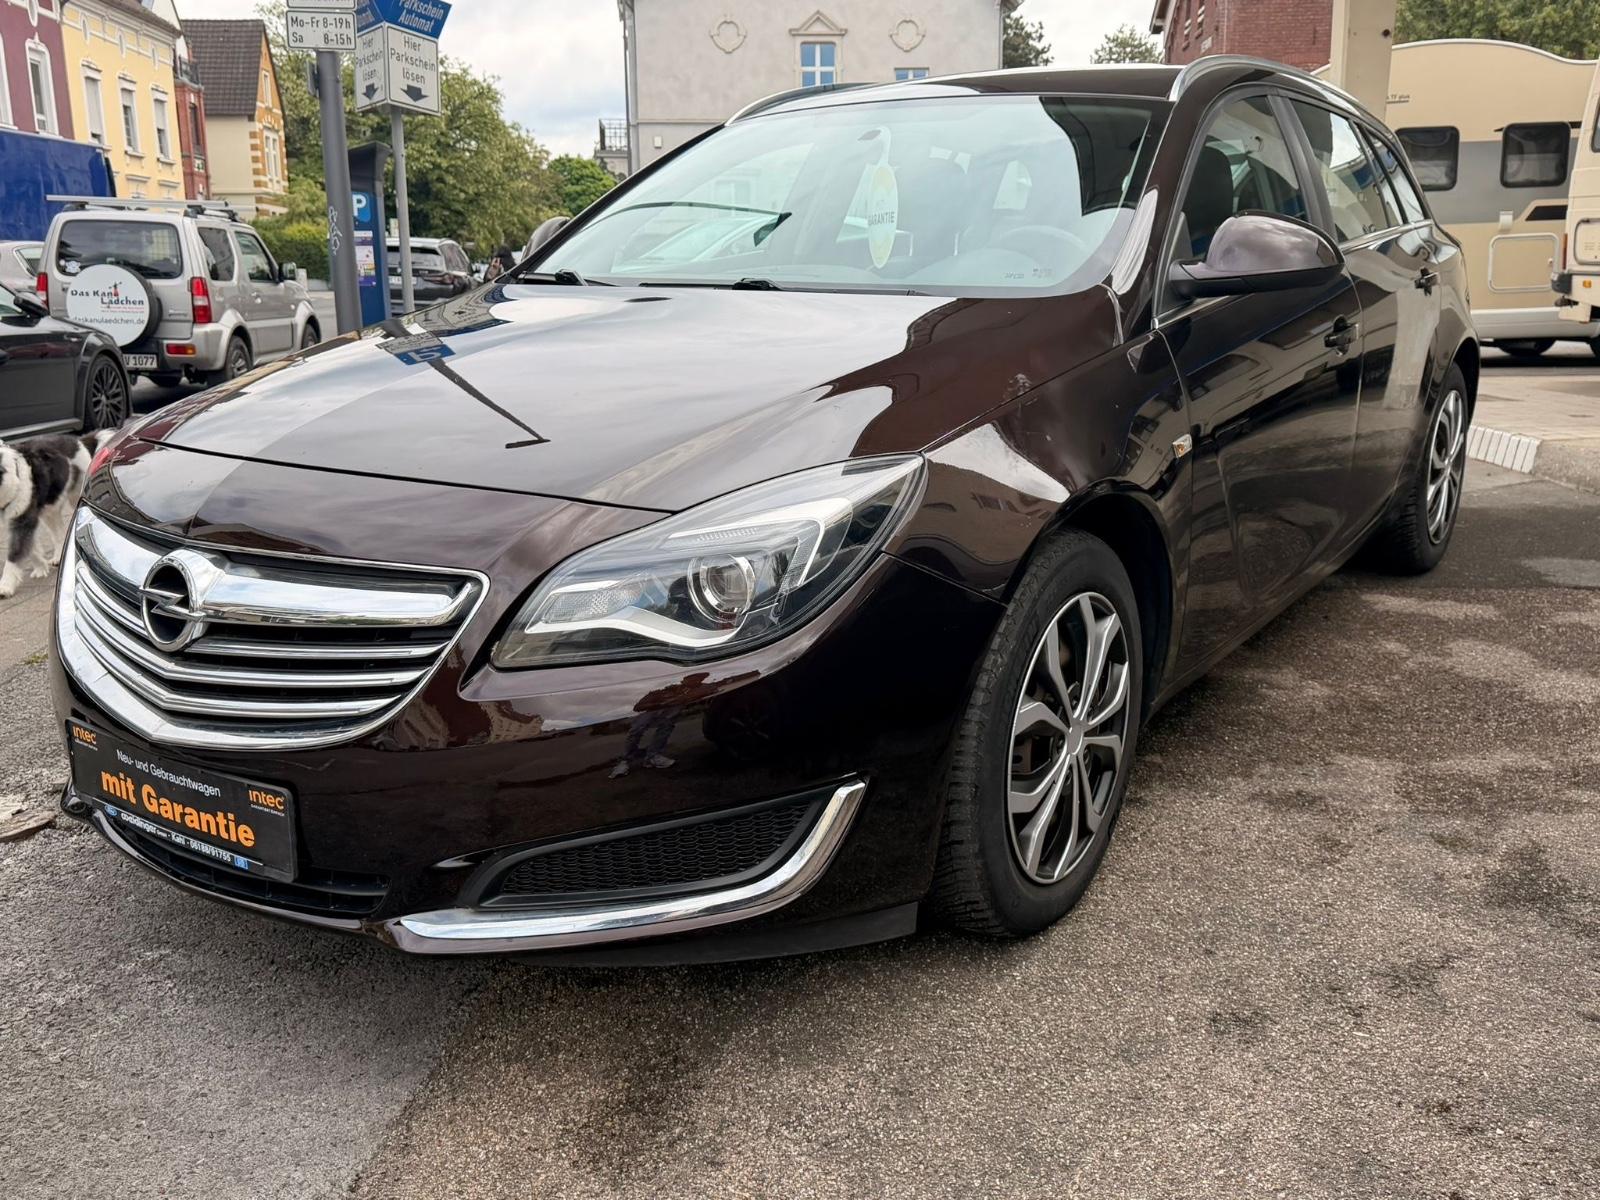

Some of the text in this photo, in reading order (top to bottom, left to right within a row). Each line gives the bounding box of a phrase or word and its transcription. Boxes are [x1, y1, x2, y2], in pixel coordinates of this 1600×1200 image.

[291, 16, 320, 28] Mo-Fr
[398, 8, 435, 33] Automat
[292, 31, 304, 43] Sa
[403, 35, 421, 51] Hier
[390, 47, 436, 72] Parkschein
[402, 67, 425, 84] lösen
[352, 194, 367, 217] P
[132, 356, 155, 366] 1077
[73, 725, 97, 745] intec
[116, 749, 221, 797] Neu- und Gebrauchtwagen
[101, 770, 255, 847] mit Garantie
[248, 789, 285, 810] intec
